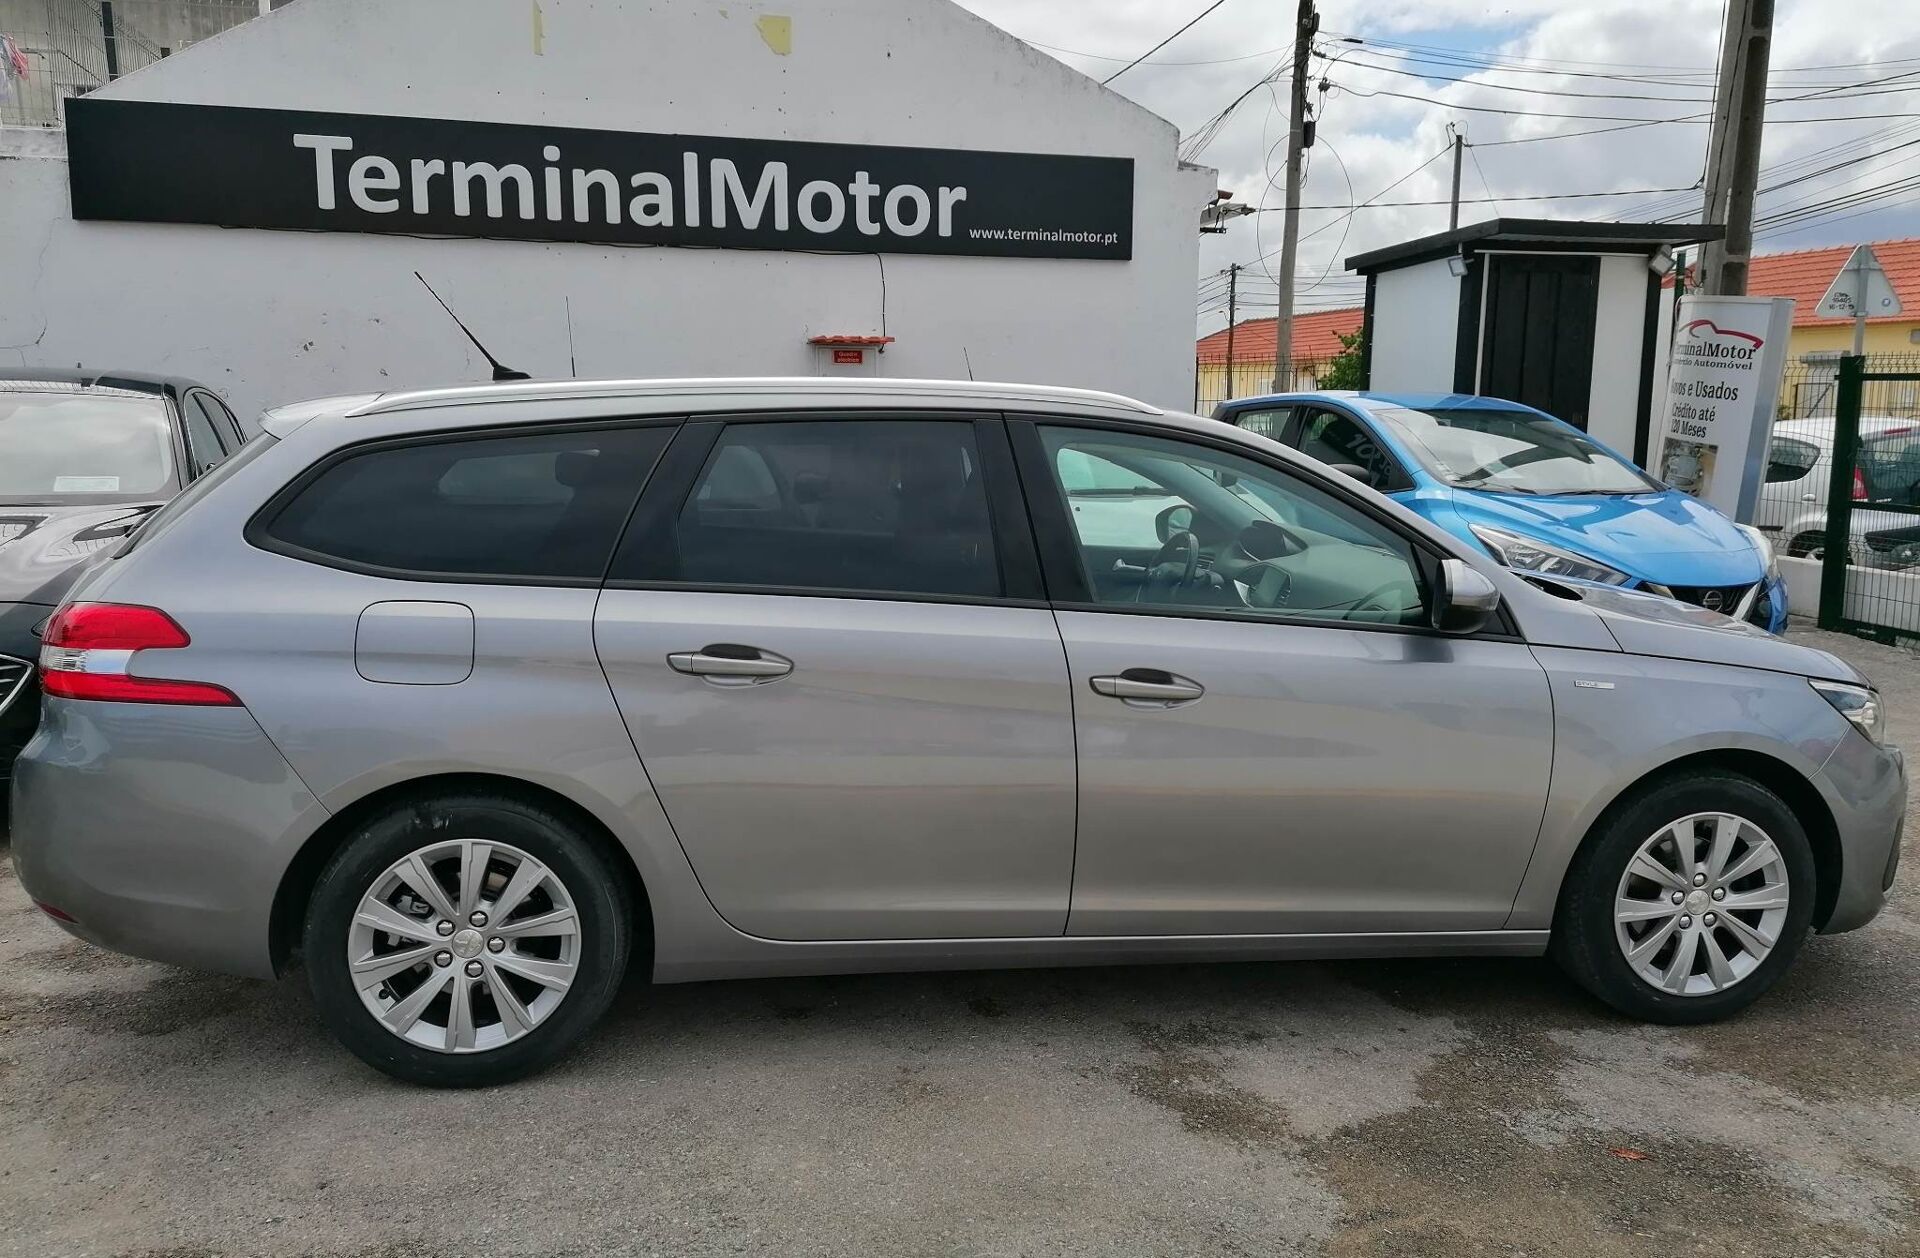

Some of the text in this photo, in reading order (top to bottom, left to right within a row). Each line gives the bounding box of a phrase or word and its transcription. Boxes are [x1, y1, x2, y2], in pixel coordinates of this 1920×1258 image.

[293, 133, 967, 236] TerminalMotor
[969, 228, 1118, 245] www.terminalmotor.pt
[1674, 341, 1756, 359] erminalMotor
[1693, 359, 1753, 370] Automóvel
[1687, 383, 1694, 397] e
[1696, 381, 1739, 401] Usados
[1671, 402, 1716, 422] Crédito até
[1680, 420, 1707, 438] Meses
